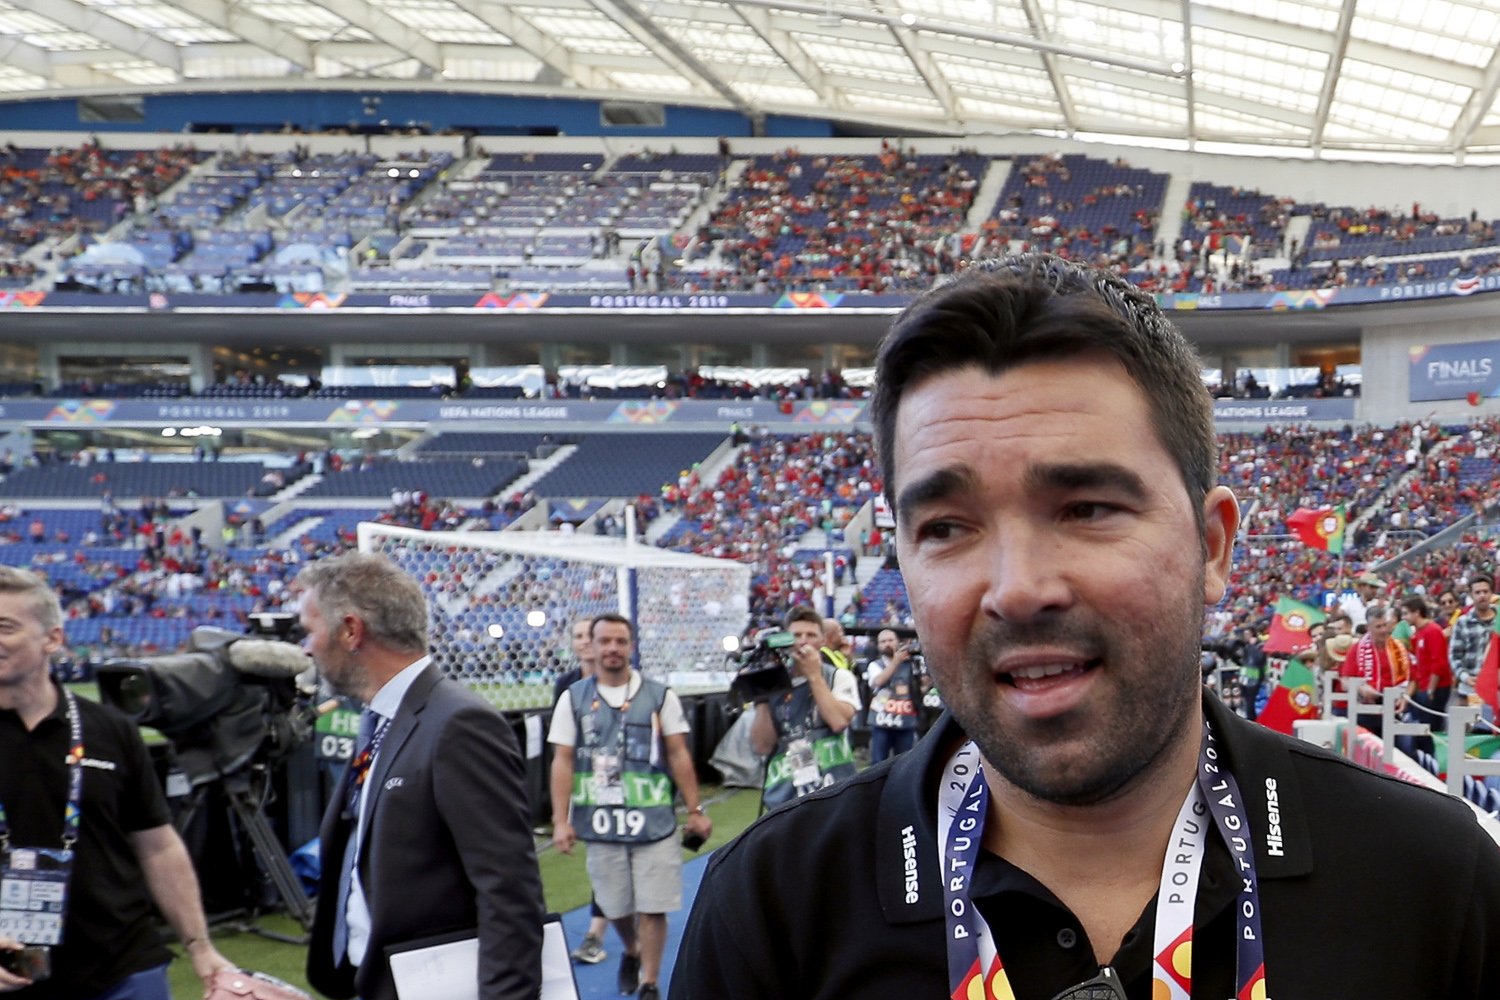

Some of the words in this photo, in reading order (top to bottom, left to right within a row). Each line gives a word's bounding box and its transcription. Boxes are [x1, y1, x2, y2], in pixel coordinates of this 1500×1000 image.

[590, 295, 681, 307] PORTUGAL
[689, 295, 728, 307] 2019
[1427, 358, 1492, 378] FINALS
[158, 405, 246, 418] PORTUGAL
[252, 405, 291, 417] 2019
[440, 407, 470, 418] UEFA
[472, 407, 519, 418] NATIONS
[523, 407, 568, 418] LEAGUE
[717, 406, 753, 417] FINALS
[1264, 406, 1308, 416] LEAGUE
[632, 776, 669, 803] TV
[592, 808, 646, 836] 019
[1265, 777, 1284, 857] Hisense
[901, 824, 919, 904] Hisense
[949, 784, 983, 939] PORTUGAL
